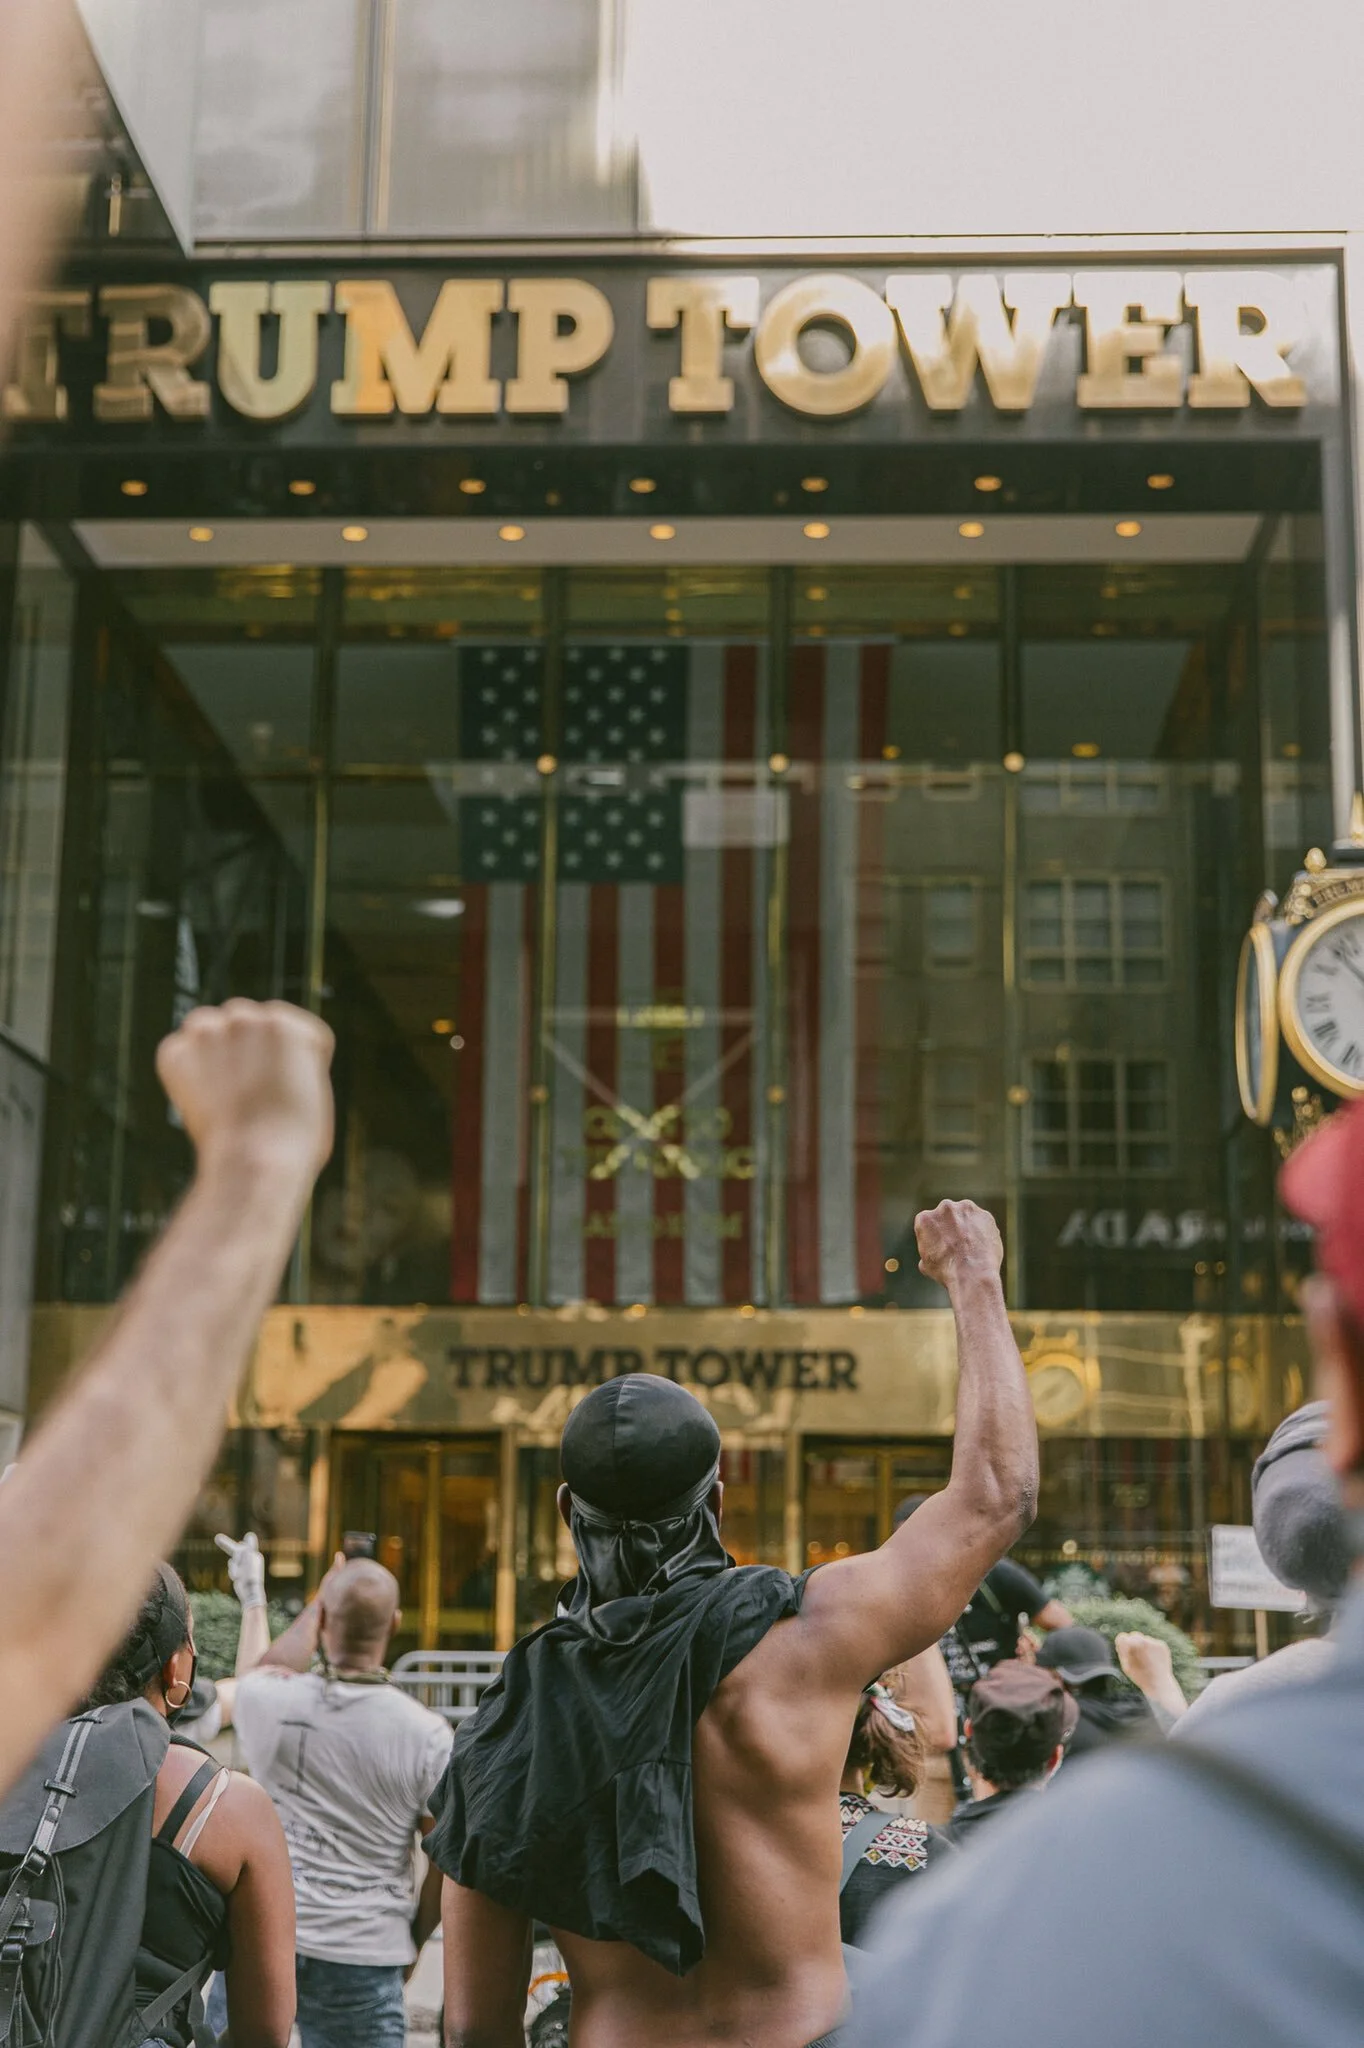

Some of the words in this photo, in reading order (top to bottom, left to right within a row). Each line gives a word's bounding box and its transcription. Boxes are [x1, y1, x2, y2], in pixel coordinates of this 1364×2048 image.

[4, 277, 614, 420] TRUMP
[647, 271, 1307, 416] TOWER
[446, 1342, 645, 1390] TRUMP
[654, 1343, 859, 1391] TOWER
